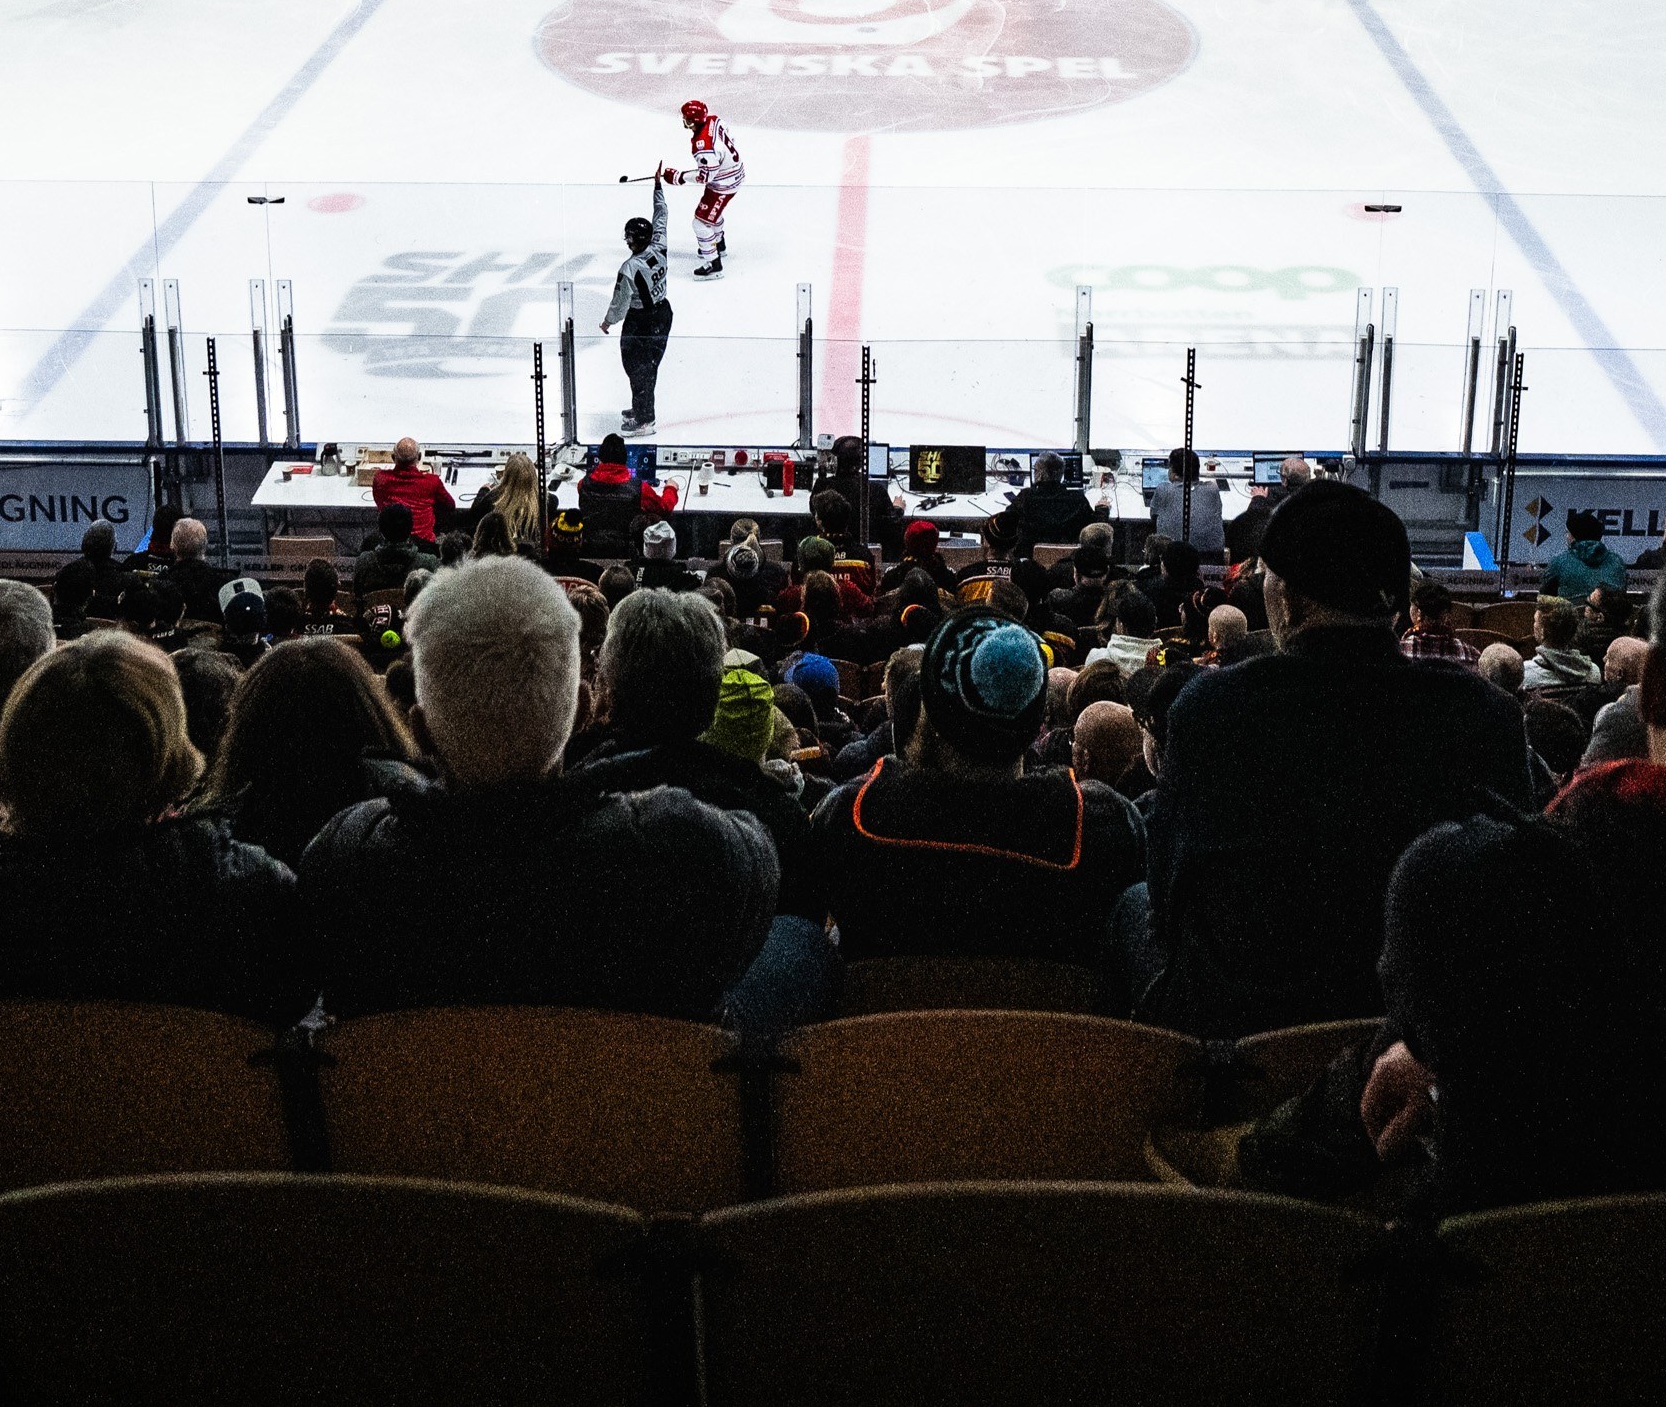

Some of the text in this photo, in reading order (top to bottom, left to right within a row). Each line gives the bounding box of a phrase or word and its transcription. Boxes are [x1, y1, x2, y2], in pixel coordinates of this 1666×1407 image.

[589, 51, 1139, 81] SVENSKA SPEL
[1043, 263, 1361, 300] coop
